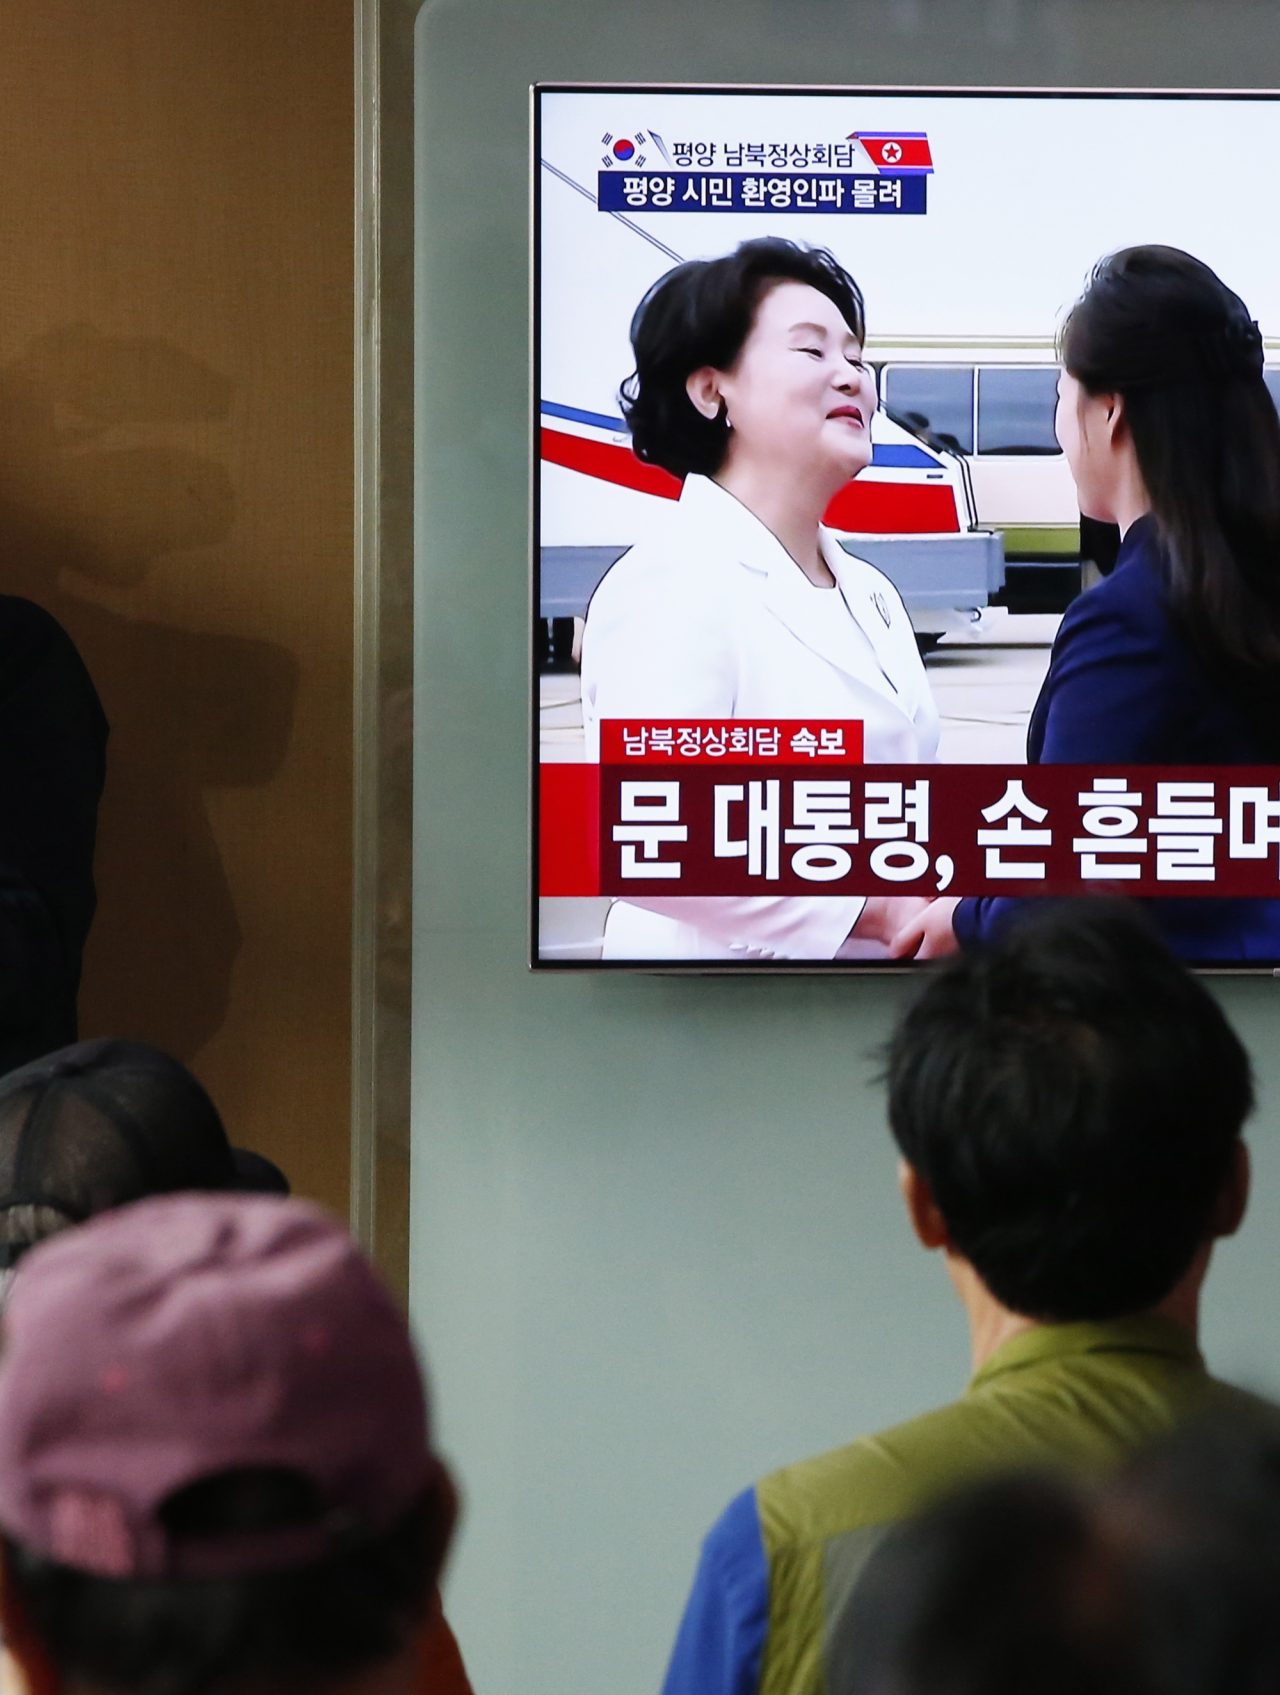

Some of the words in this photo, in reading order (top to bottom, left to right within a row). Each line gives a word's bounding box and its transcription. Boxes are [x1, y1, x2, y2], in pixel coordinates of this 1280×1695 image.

[672, 142, 717, 168] 평양
[724, 142, 856, 168] 남북정상회담
[623, 176, 675, 207] 평양
[682, 176, 733, 207] 시민
[741, 177, 845, 208] 환영인파
[851, 179, 902, 208] 몰려
[622, 726, 782, 757] 남북정상회담
[790, 727, 846, 758] 속보
[612, 781, 688, 879] 문
[714, 779, 954, 892] 대통령,
[977, 779, 1052, 879] 손
